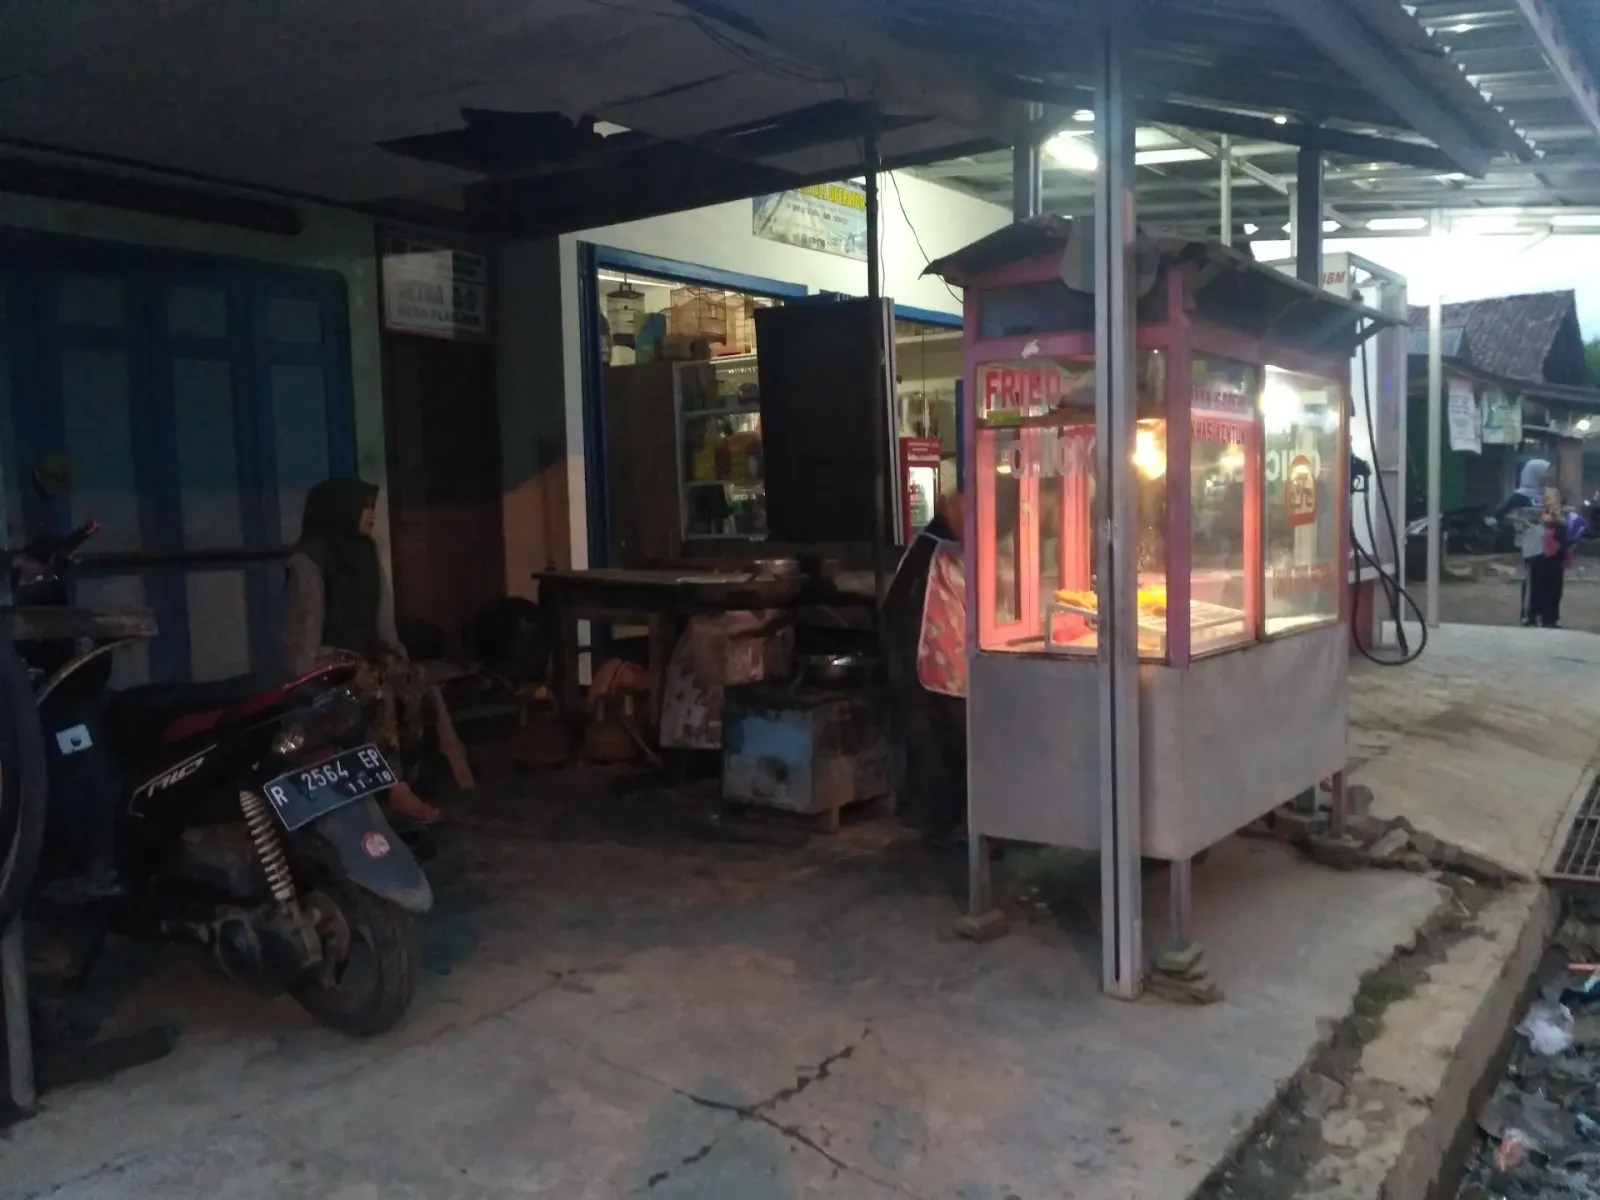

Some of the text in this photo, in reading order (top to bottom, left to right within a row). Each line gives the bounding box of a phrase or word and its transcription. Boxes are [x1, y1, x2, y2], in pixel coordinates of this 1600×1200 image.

[985, 366, 1061, 410] FRIED
[270, 748, 380, 807] R 2564 EP
